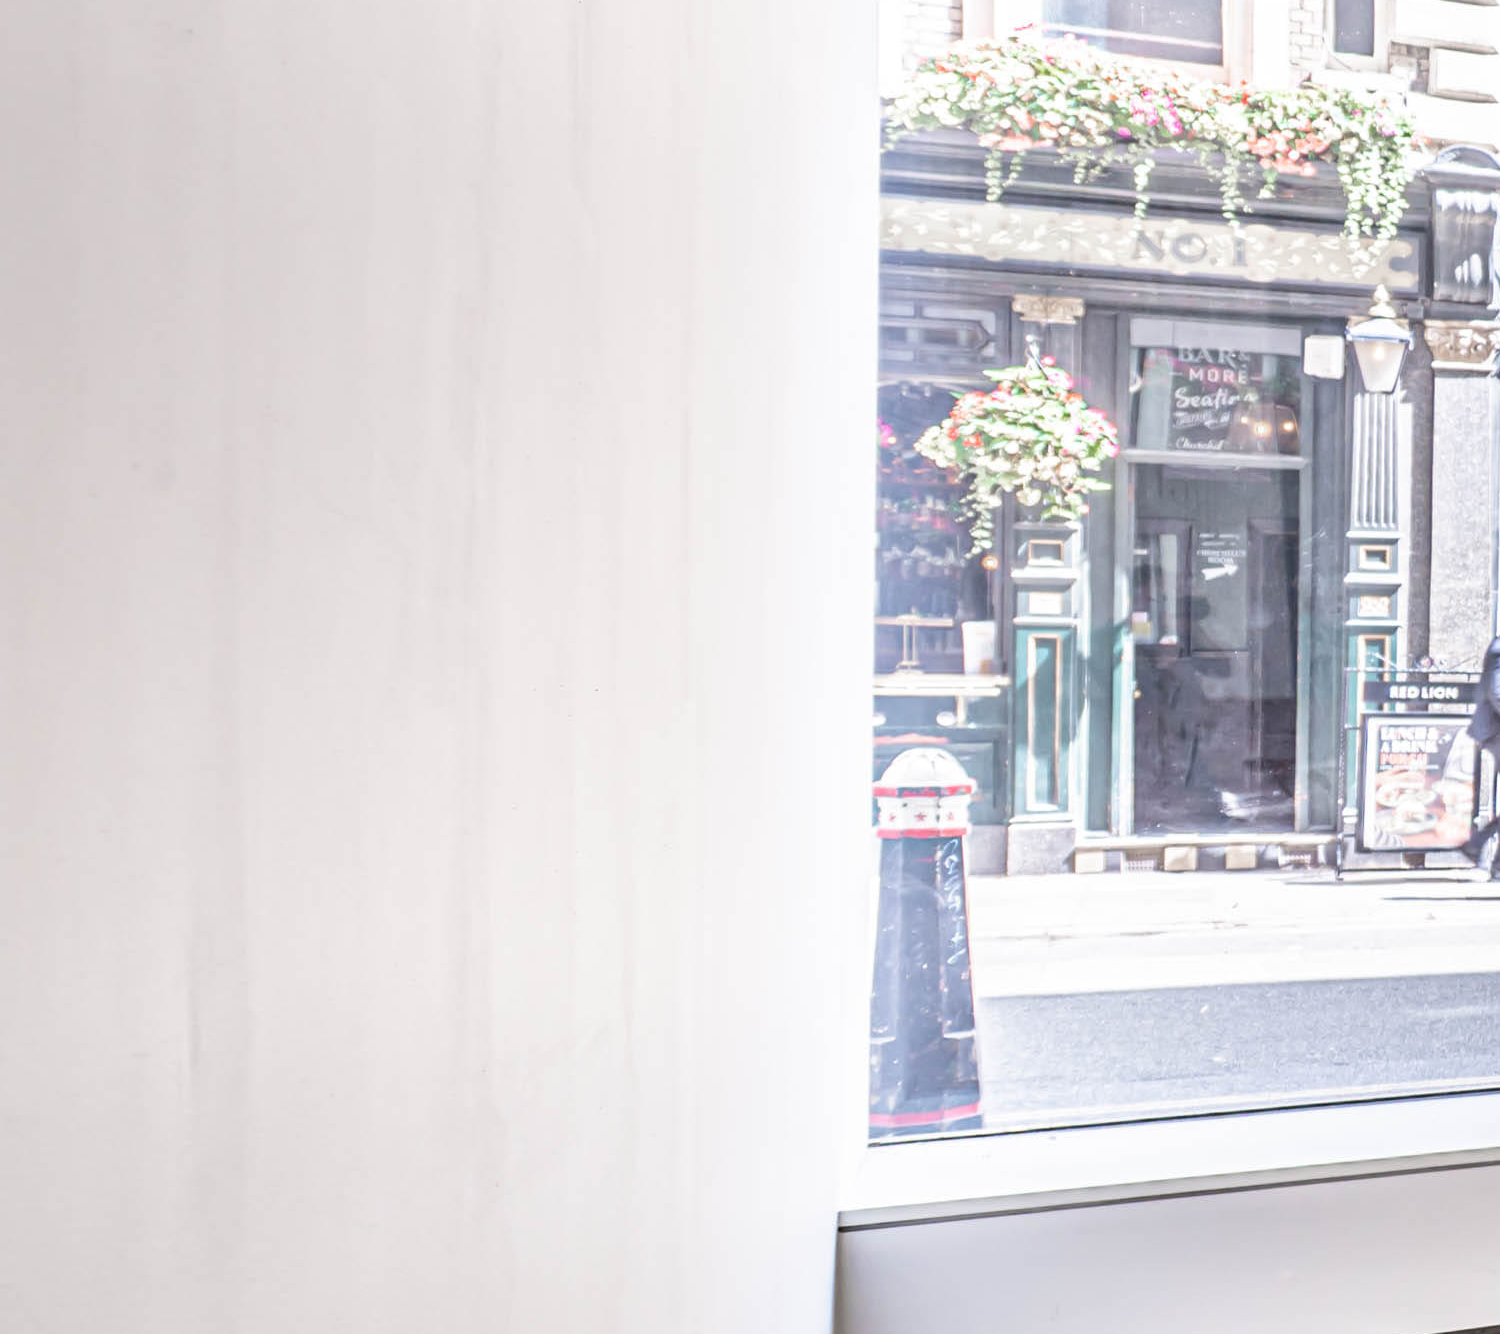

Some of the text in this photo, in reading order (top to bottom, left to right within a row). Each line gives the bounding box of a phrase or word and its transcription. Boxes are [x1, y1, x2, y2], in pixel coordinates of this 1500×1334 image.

[1188, 368, 1248, 384] MORE
[1389, 685, 1459, 700] RED LION
